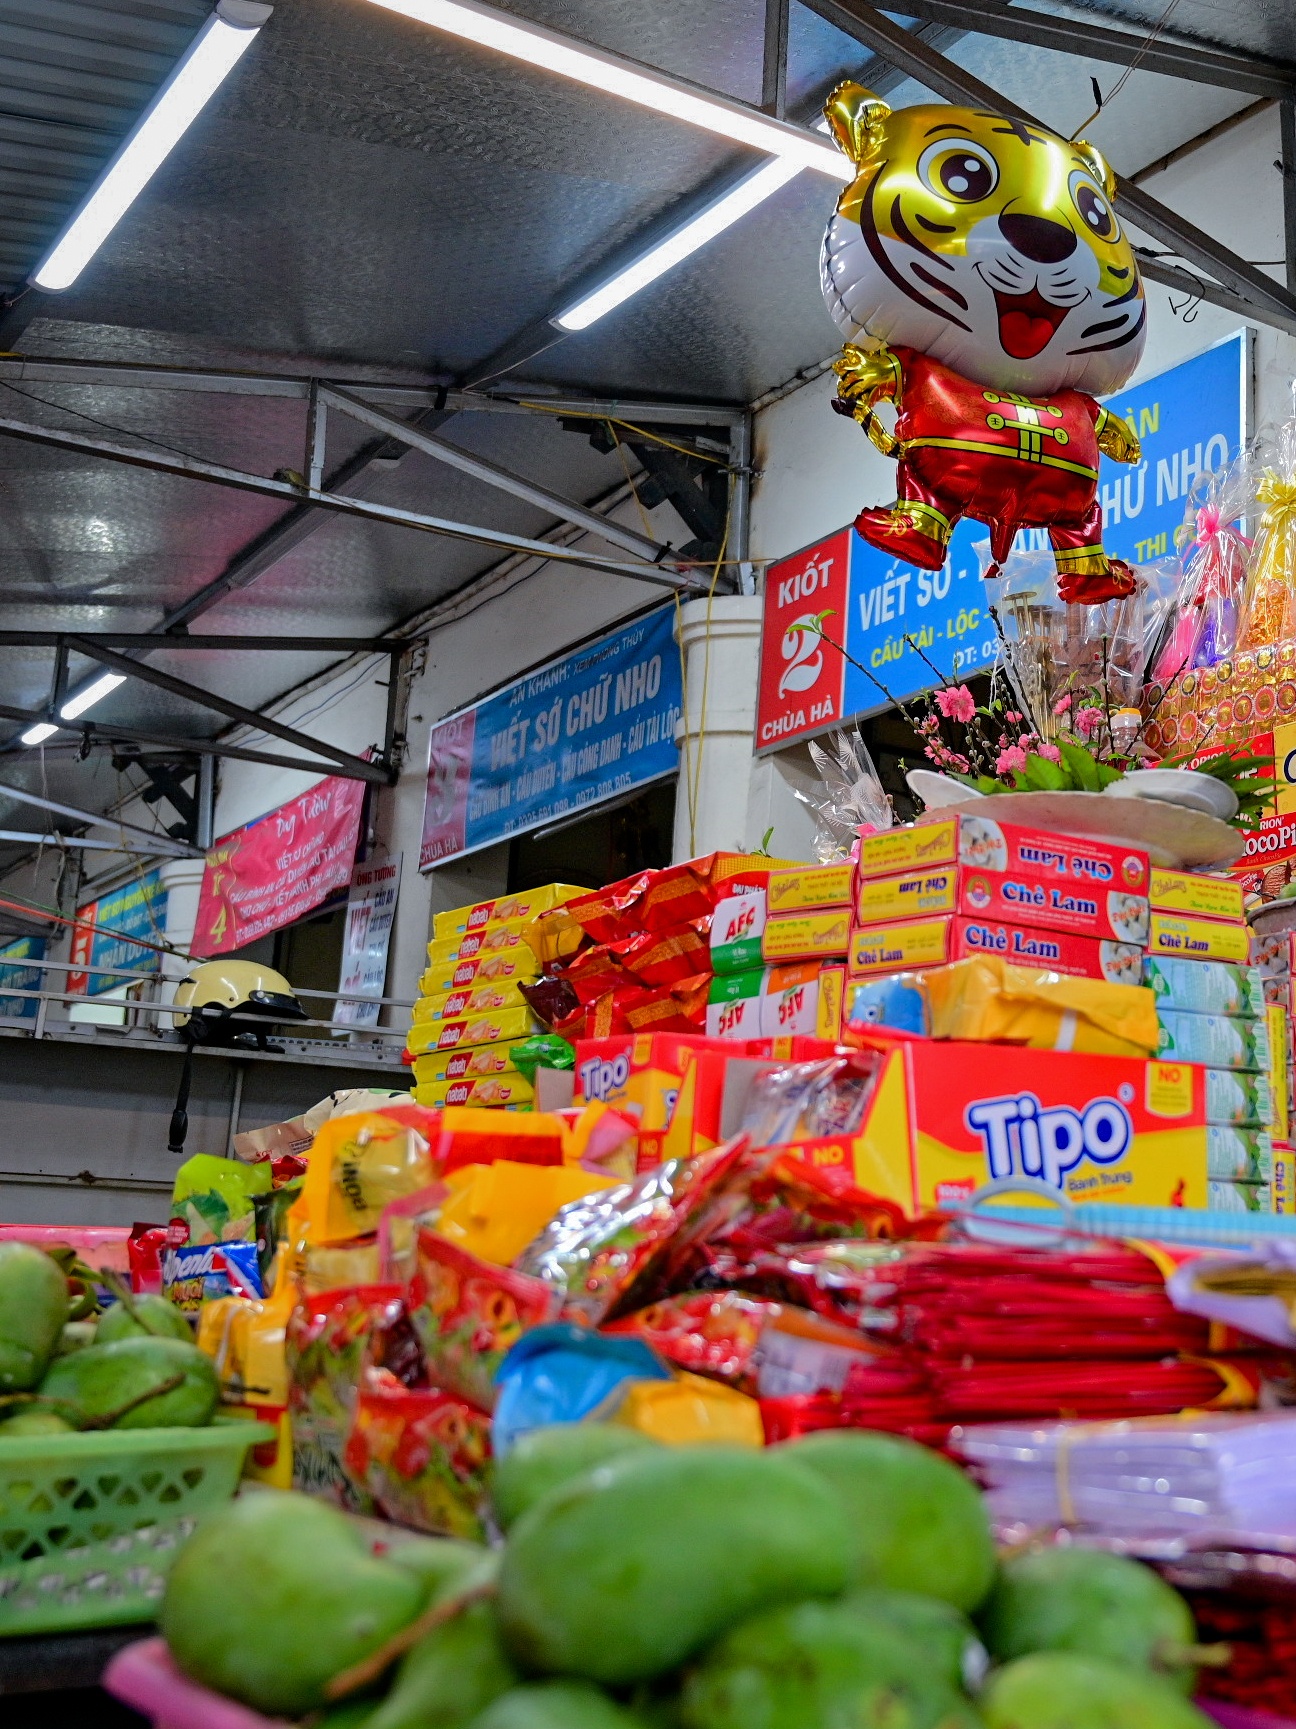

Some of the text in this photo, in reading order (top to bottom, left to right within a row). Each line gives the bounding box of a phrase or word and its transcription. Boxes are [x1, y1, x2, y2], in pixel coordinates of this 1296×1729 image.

[1098, 433, 1230, 530] HỮ NHO
[1134, 531, 1167, 564] THI
[777, 553, 834, 609] KIỐT
[858, 560, 912, 631] VIẾT
[779, 612, 824, 700] 2
[870, 608, 980, 669] CẦU TÀI LỘC
[566, 678, 615, 737] CHỮ
[614, 654, 663, 716] NHO
[762, 697, 835, 742] CHÙA HÀ
[1259, 816, 1283, 831] RION
[1020, 846, 1065, 873] Lam
[1001, 881, 1045, 905] Chè
[1052, 889, 1098, 915] Lam
[725, 905, 756, 943] AFC
[965, 924, 1060, 959] Chè Lam
[1183, 936, 1209, 952] Lam
[718, 1000, 746, 1036] AFC
[778, 985, 806, 1026] AFC
[1157, 1068, 1181, 1084] NO
[811, 1144, 845, 1166] NO
[965, 1092, 1132, 1191] Tipo
